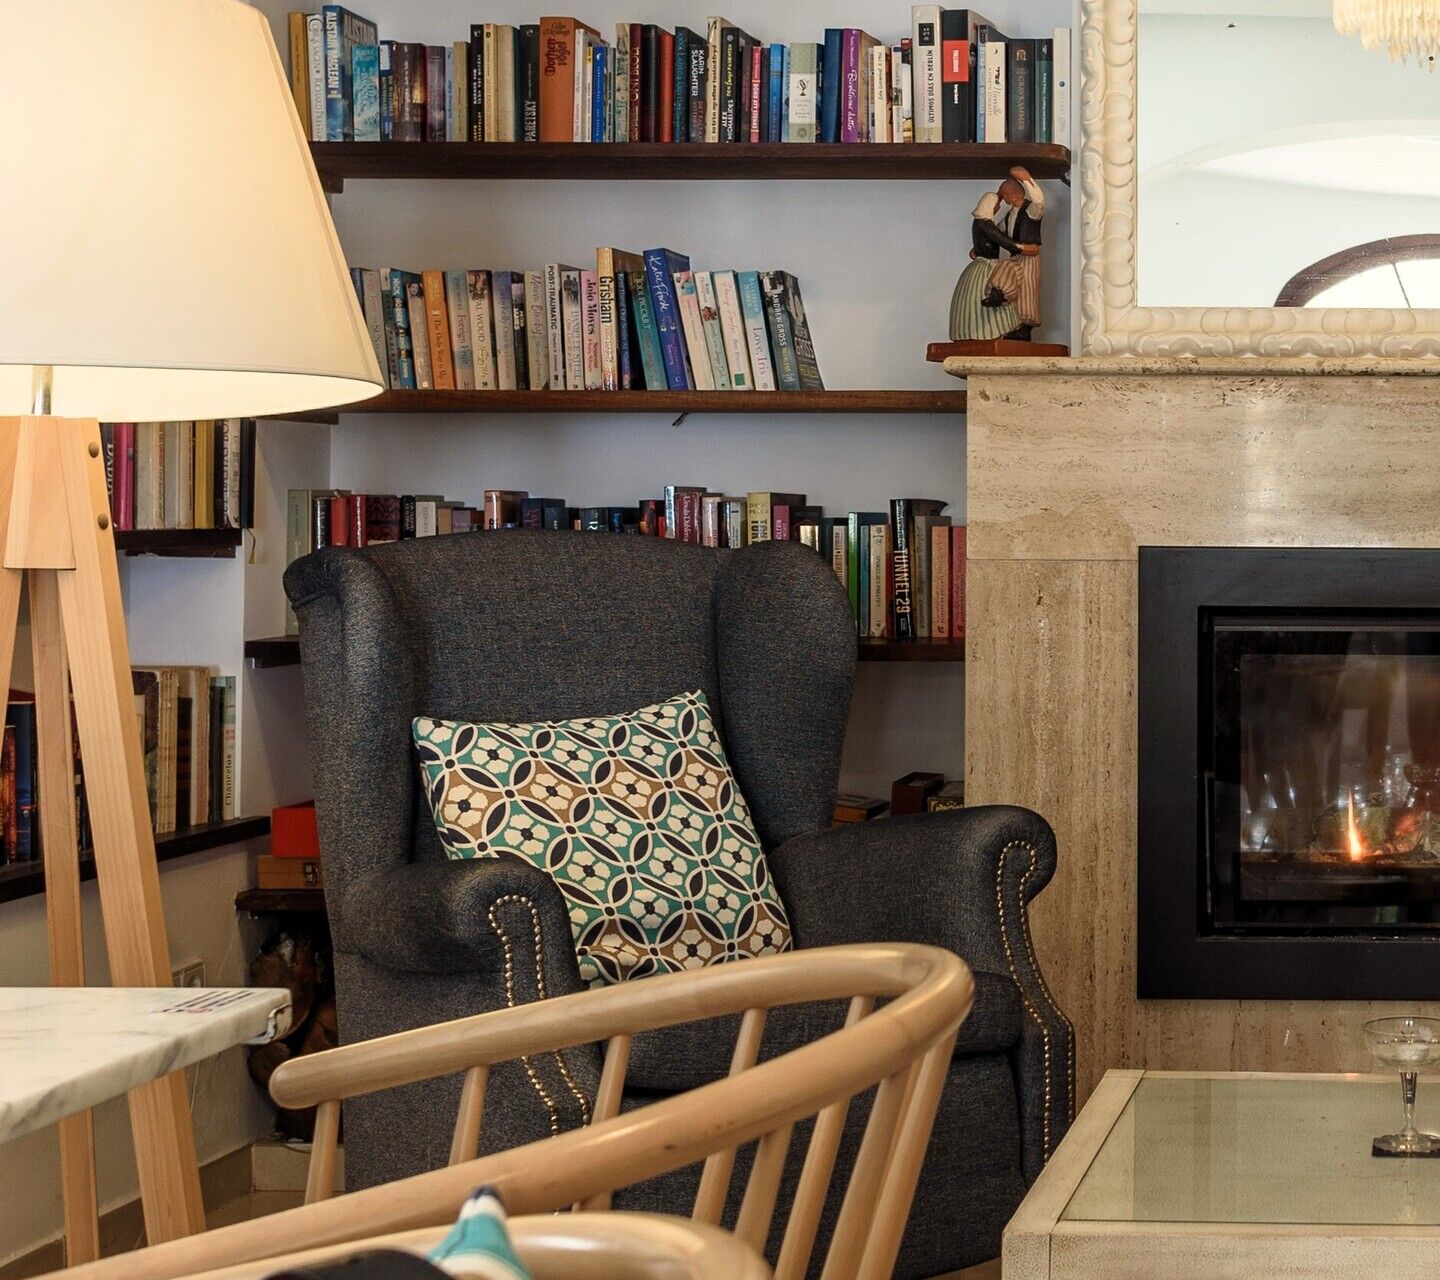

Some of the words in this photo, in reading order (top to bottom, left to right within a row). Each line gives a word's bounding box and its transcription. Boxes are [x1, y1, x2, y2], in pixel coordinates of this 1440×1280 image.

[328, 50, 339, 88] MACLEAN
[524, 100, 536, 142] PARETSKY
[648, 255, 662, 285] Katie
[548, 266, 557, 330] POST-TRAUMATIC
[587, 280, 596, 301] Jojo
[600, 276, 613, 323] Grisham
[394, 298, 404, 326] HORNBY
[638, 298, 650, 329] PICOULT
[772, 294, 782, 323] ANDREW
[777, 324, 787, 346] GROSS
[458, 315, 466, 343] Foreign
[477, 314, 485, 342] WOOD
[572, 311, 580, 350] DANIELLE
[753, 327, 764, 355] Love,
[460, 345, 468, 365] Fruit
[573, 354, 581, 380] STEEL
[757, 357, 768, 375] Iris
[893, 548, 909, 595] TUNNEL
[896, 598, 910, 613] 29
